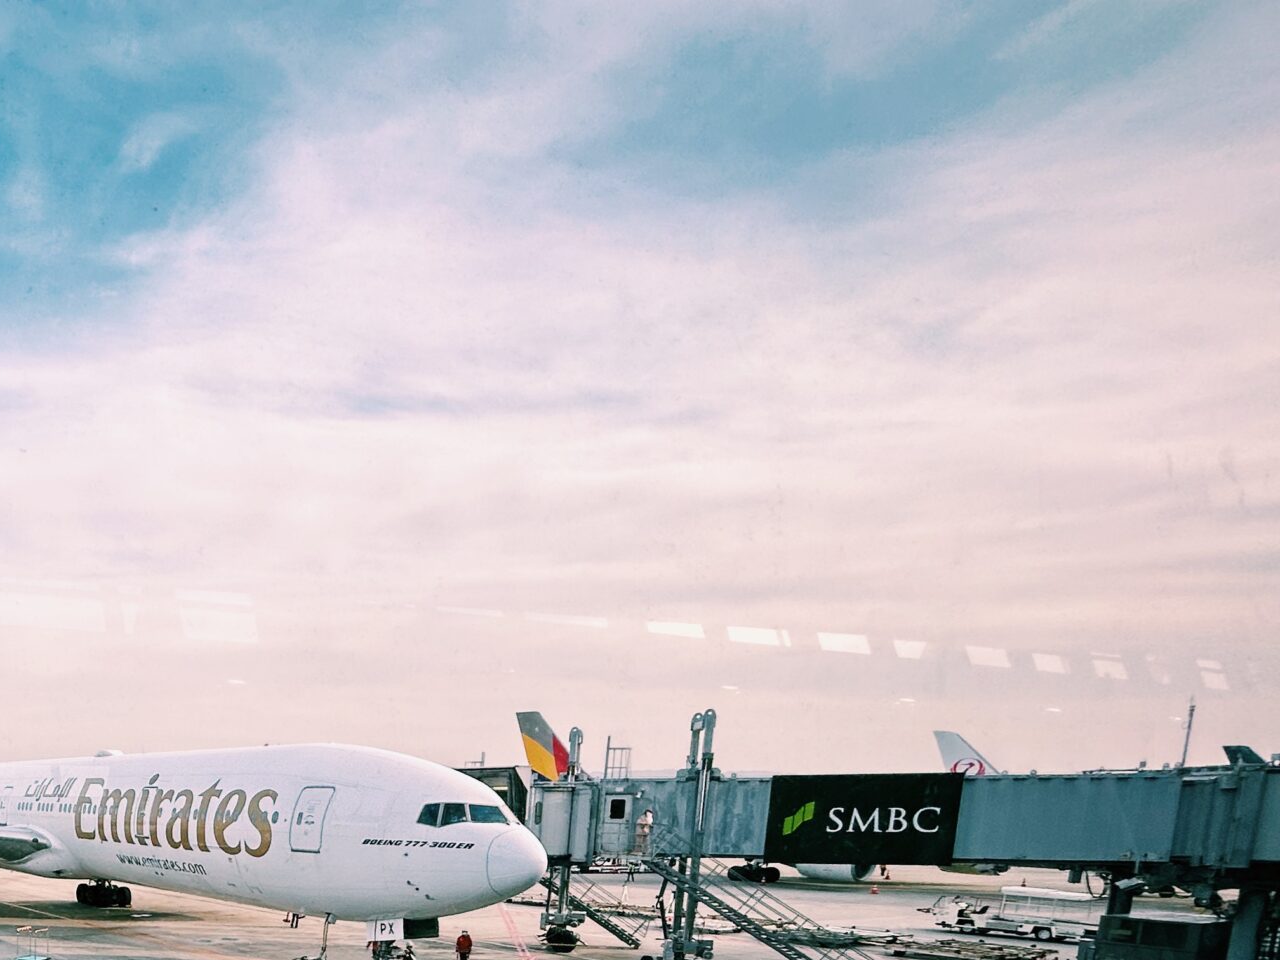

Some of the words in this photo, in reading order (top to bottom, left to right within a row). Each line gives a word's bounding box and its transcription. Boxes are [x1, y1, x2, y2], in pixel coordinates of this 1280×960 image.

[74, 773, 279, 858] Emirates
[825, 806, 942, 833] SMBC
[362, 838, 403, 847] BOEING
[404, 840, 475, 850] 777-300ER
[116, 853, 208, 876] www.emirates.com
[380, 922, 395, 935] PX
